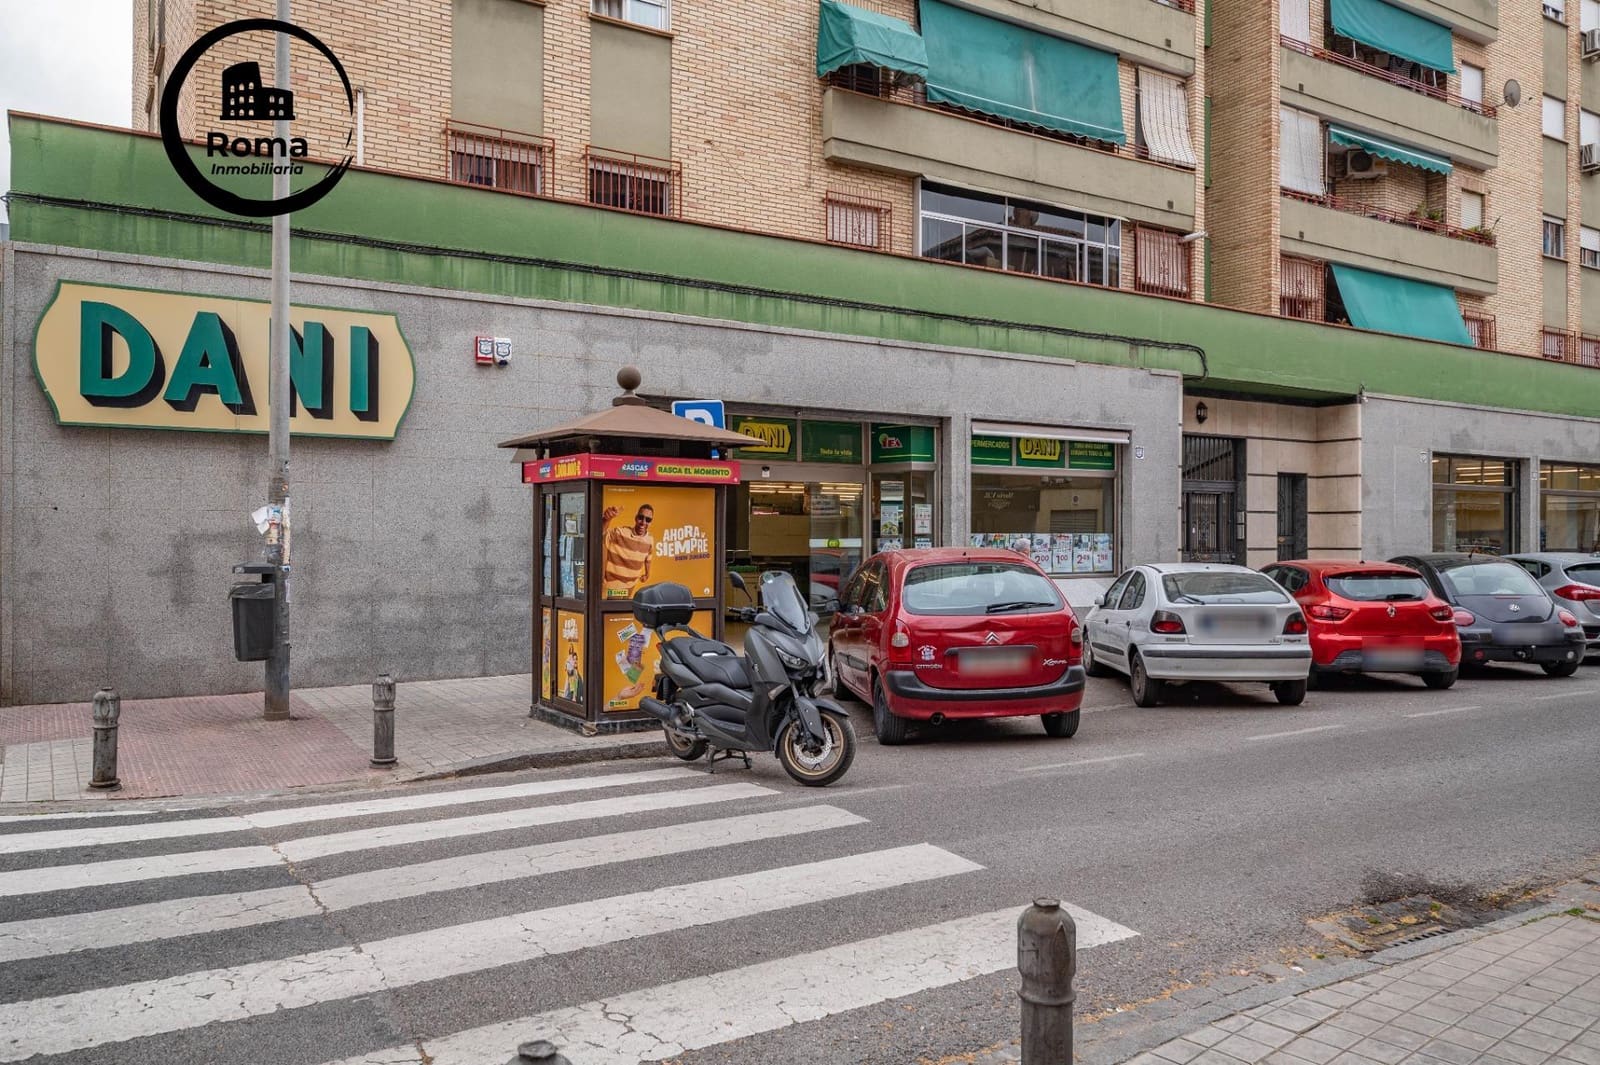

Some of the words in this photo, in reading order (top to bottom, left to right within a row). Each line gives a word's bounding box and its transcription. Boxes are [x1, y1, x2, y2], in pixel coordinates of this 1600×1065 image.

[80, 300, 379, 422] DANI
[1024, 438, 1057, 457] DANI
[621, 463, 649, 471] RASCAS
[658, 466, 682, 474] RASCA
[694, 468, 730, 476] MOMENTO
[663, 525, 700, 541] AHORA
[656, 538, 708, 557] SIEMPRE
